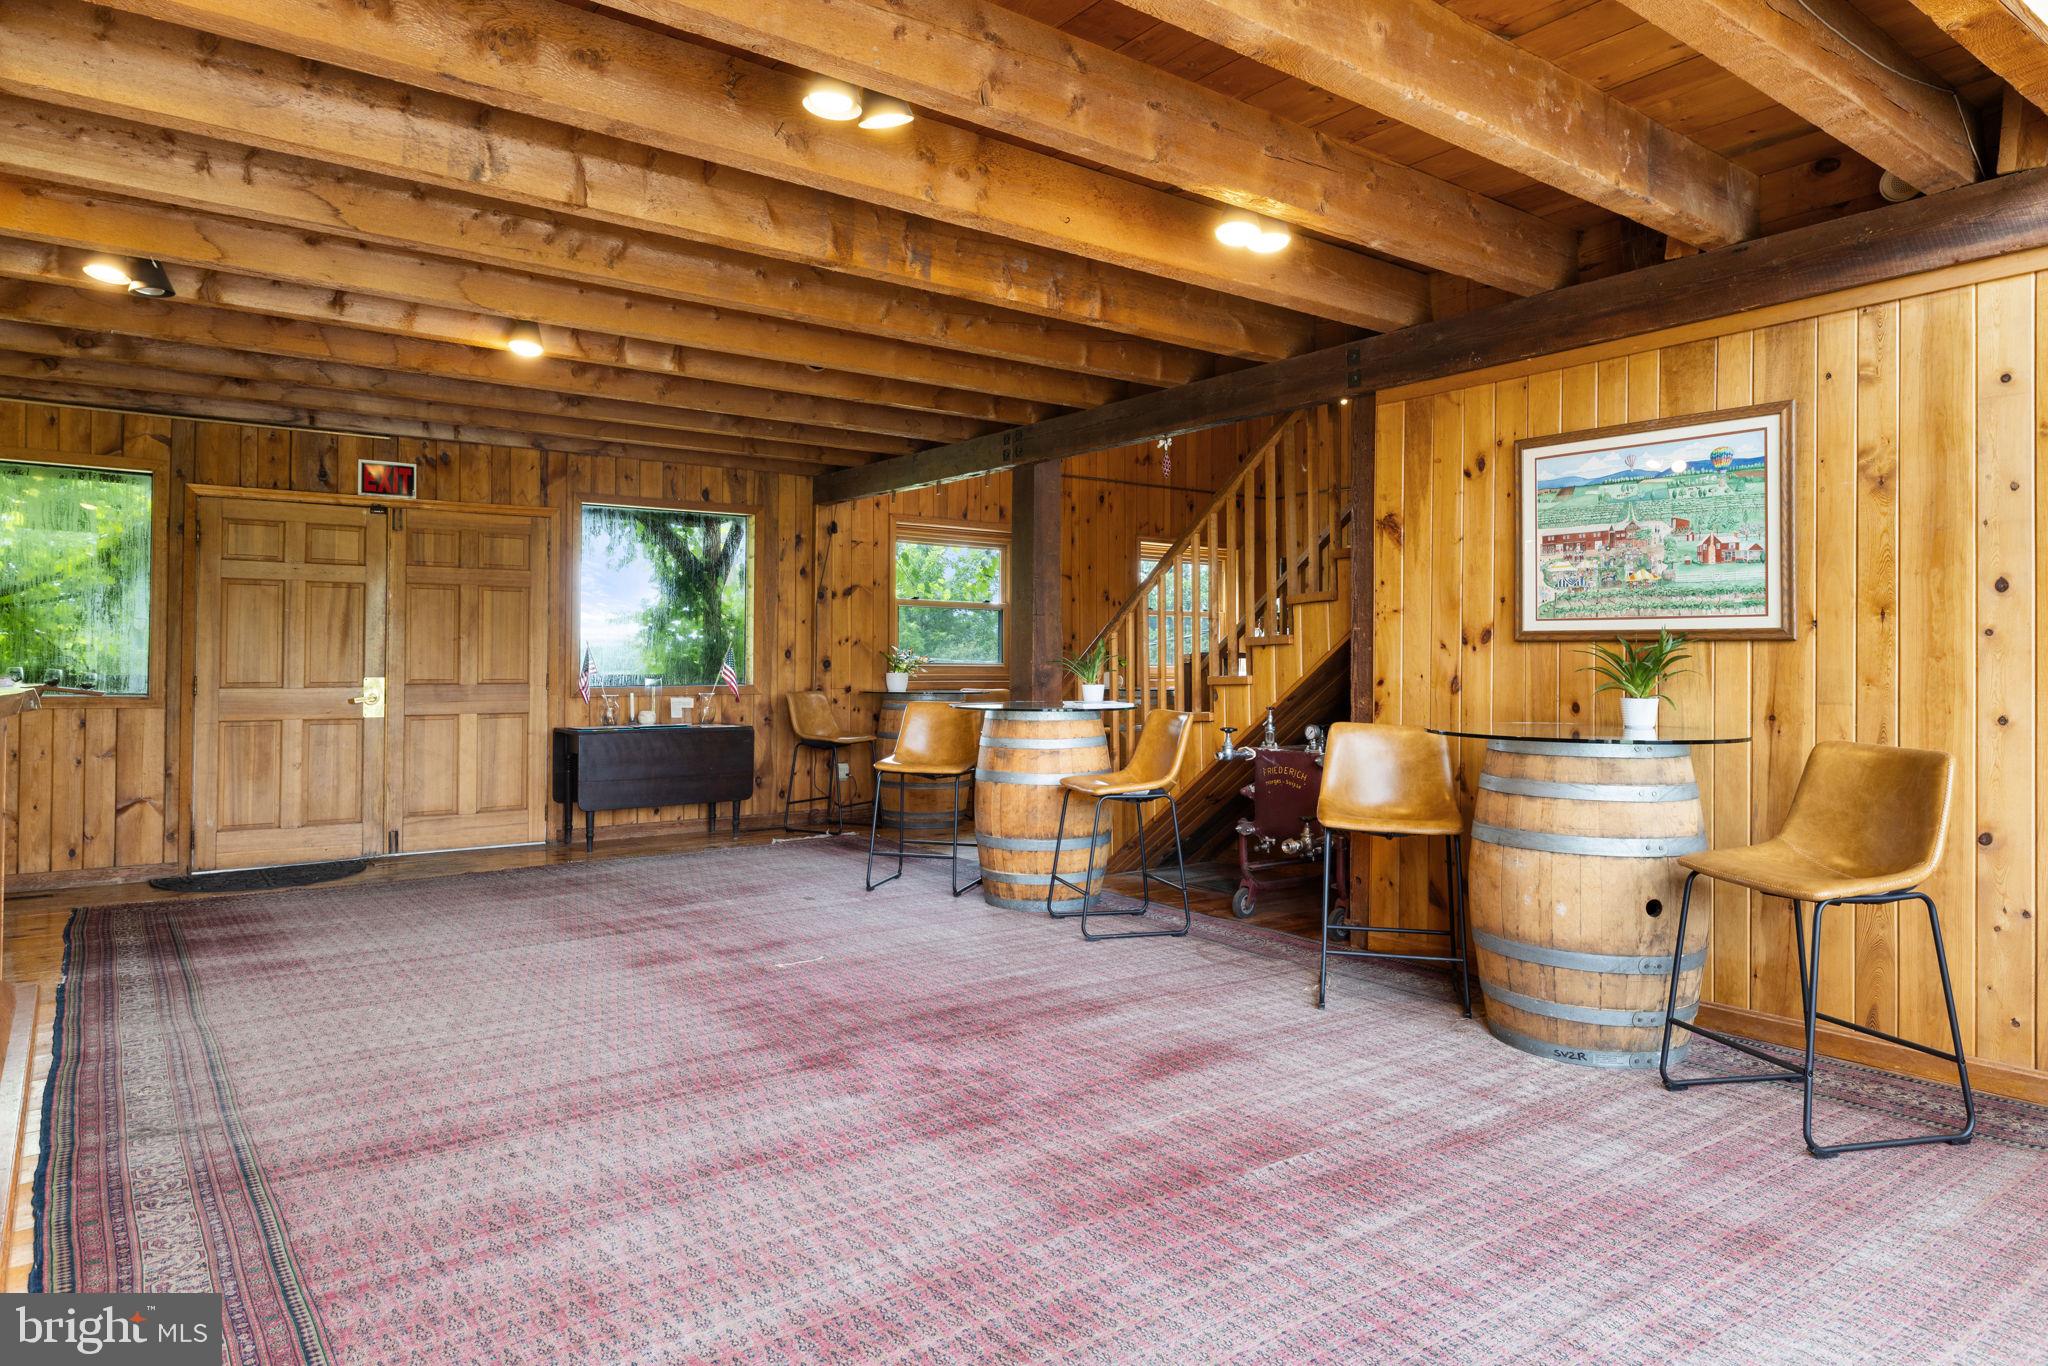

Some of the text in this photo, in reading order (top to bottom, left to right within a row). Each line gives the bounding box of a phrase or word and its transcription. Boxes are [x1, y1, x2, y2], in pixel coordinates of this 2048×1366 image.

[363, 464, 413, 496] EXIT
[1263, 766, 1308, 781] FRIEDERICH
[1553, 1049, 1588, 1061] SV2R
